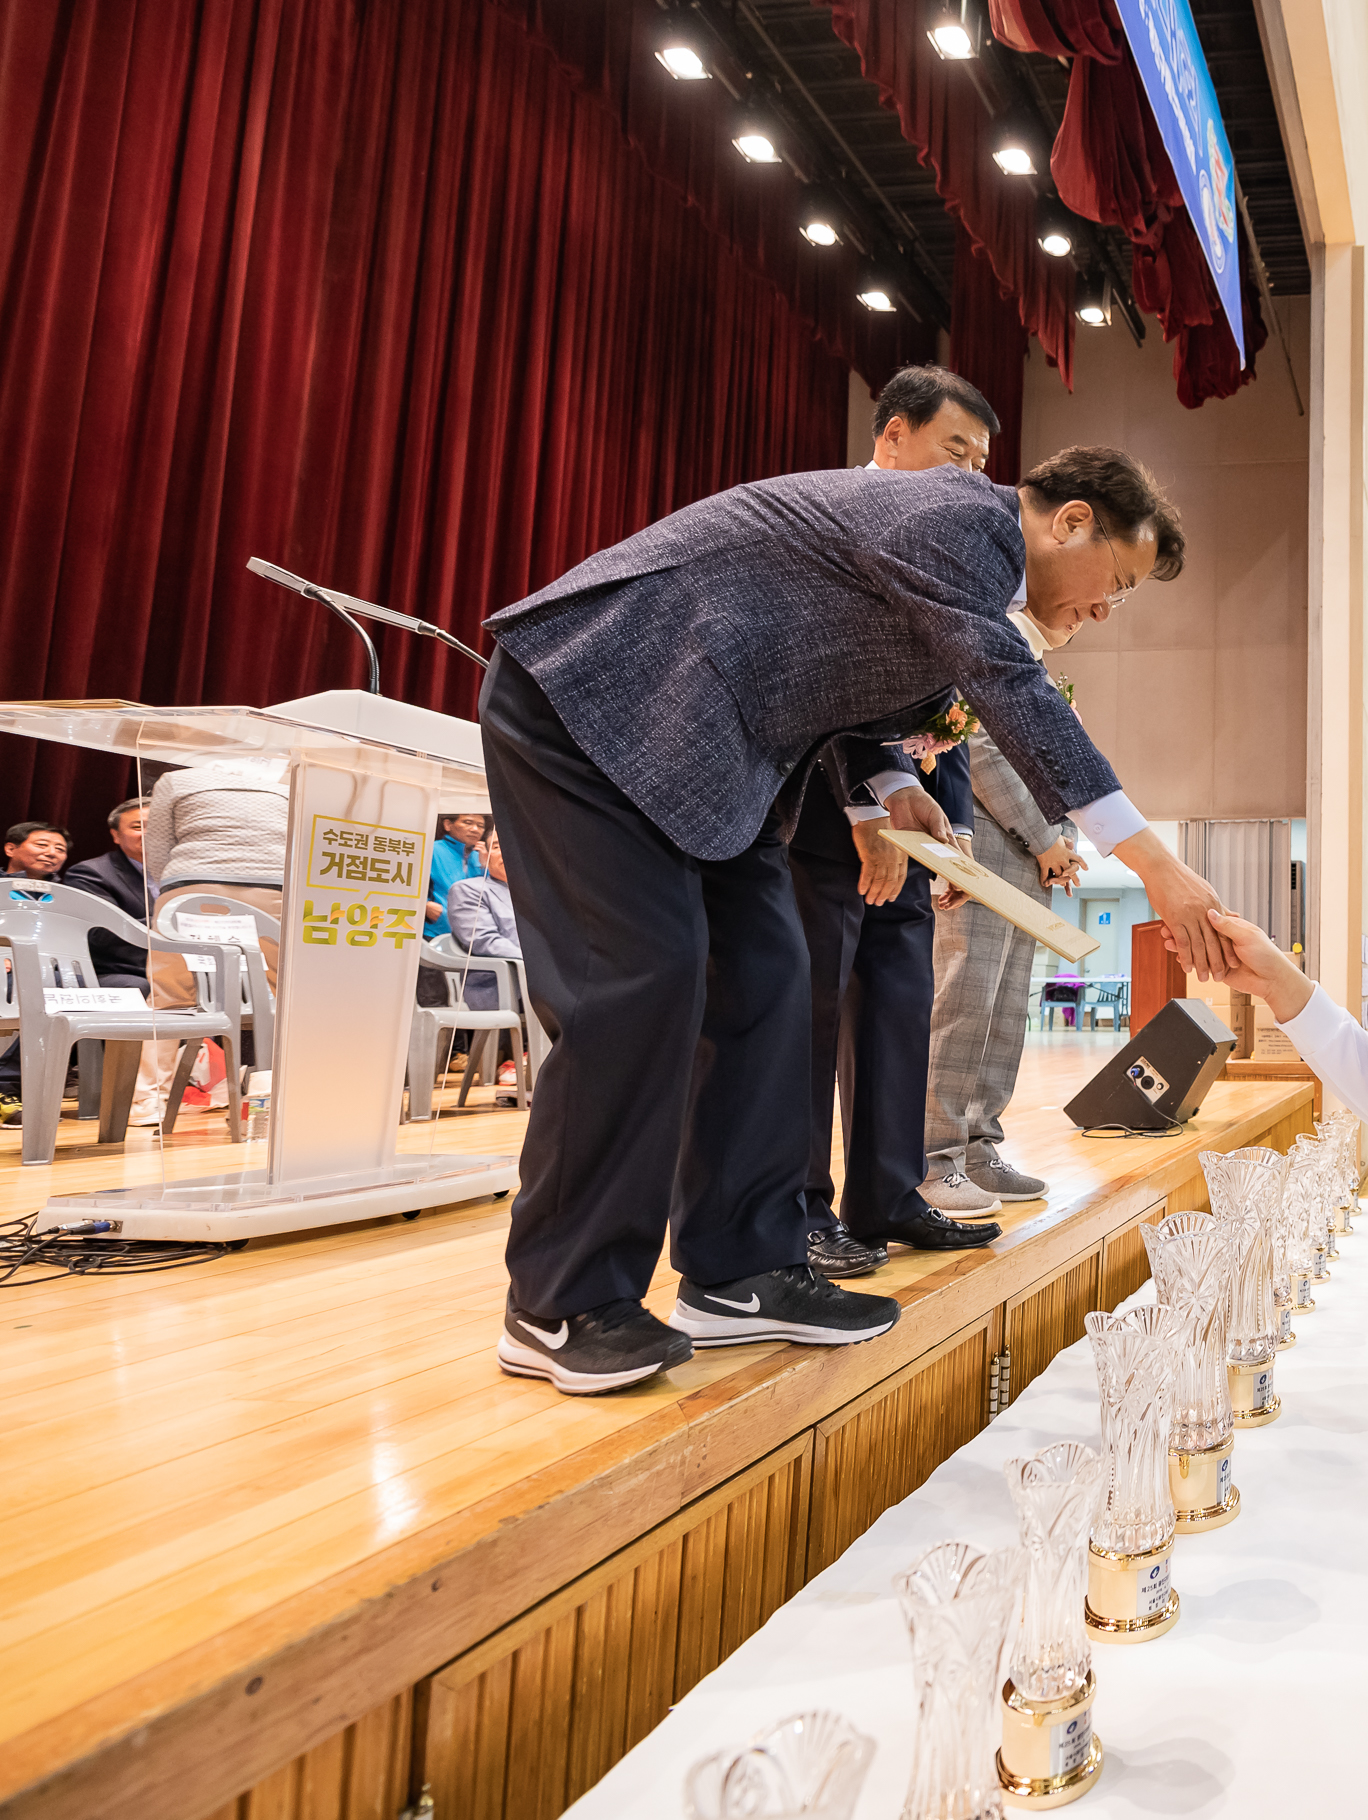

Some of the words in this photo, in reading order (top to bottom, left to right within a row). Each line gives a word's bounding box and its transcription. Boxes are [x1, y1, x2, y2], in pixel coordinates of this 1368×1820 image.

[322, 828, 369, 851] 수도권
[372, 835, 415, 857] 동북부
[319, 851, 413, 887] 거점도시
[302, 899, 417, 950] 남양주
